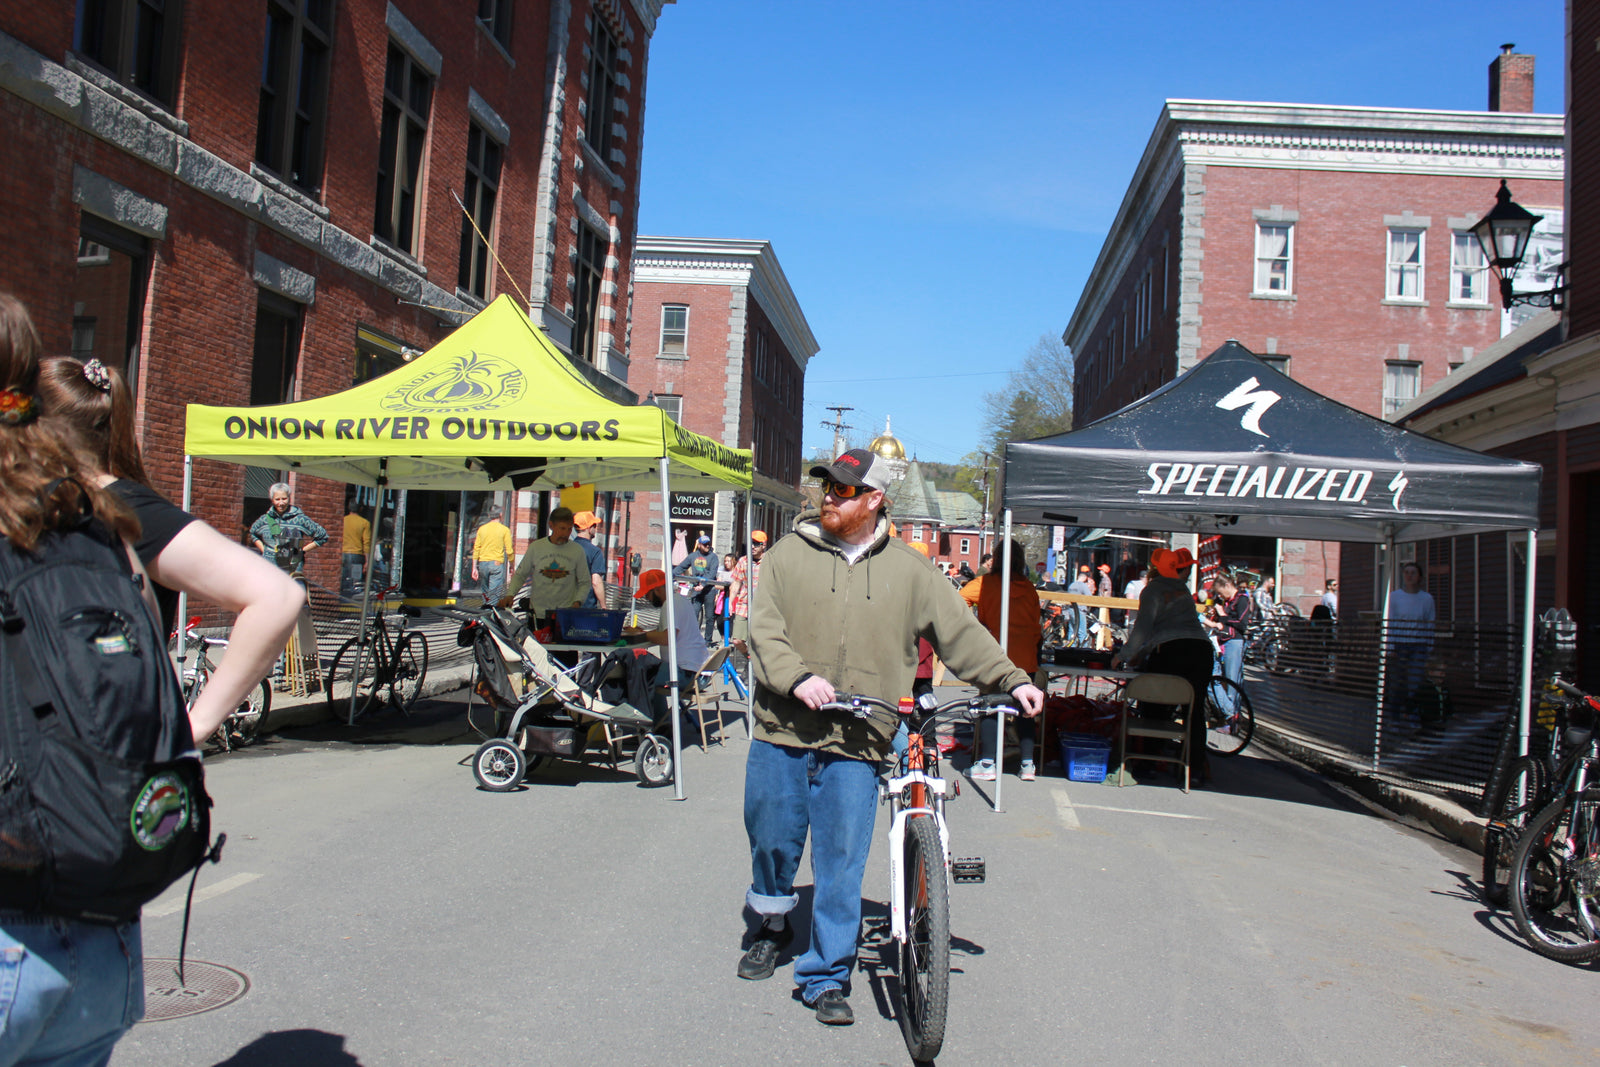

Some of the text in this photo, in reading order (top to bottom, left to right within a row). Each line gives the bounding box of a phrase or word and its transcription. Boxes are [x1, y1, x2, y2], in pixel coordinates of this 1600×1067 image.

[497, 368, 523, 399] River
[224, 415, 620, 441] ONION RIVER OUTDOORS
[1137, 462, 1374, 502] SPECIALIZED
[671, 506, 712, 517] CLOTHING
[675, 495, 710, 505] VINTAGE
